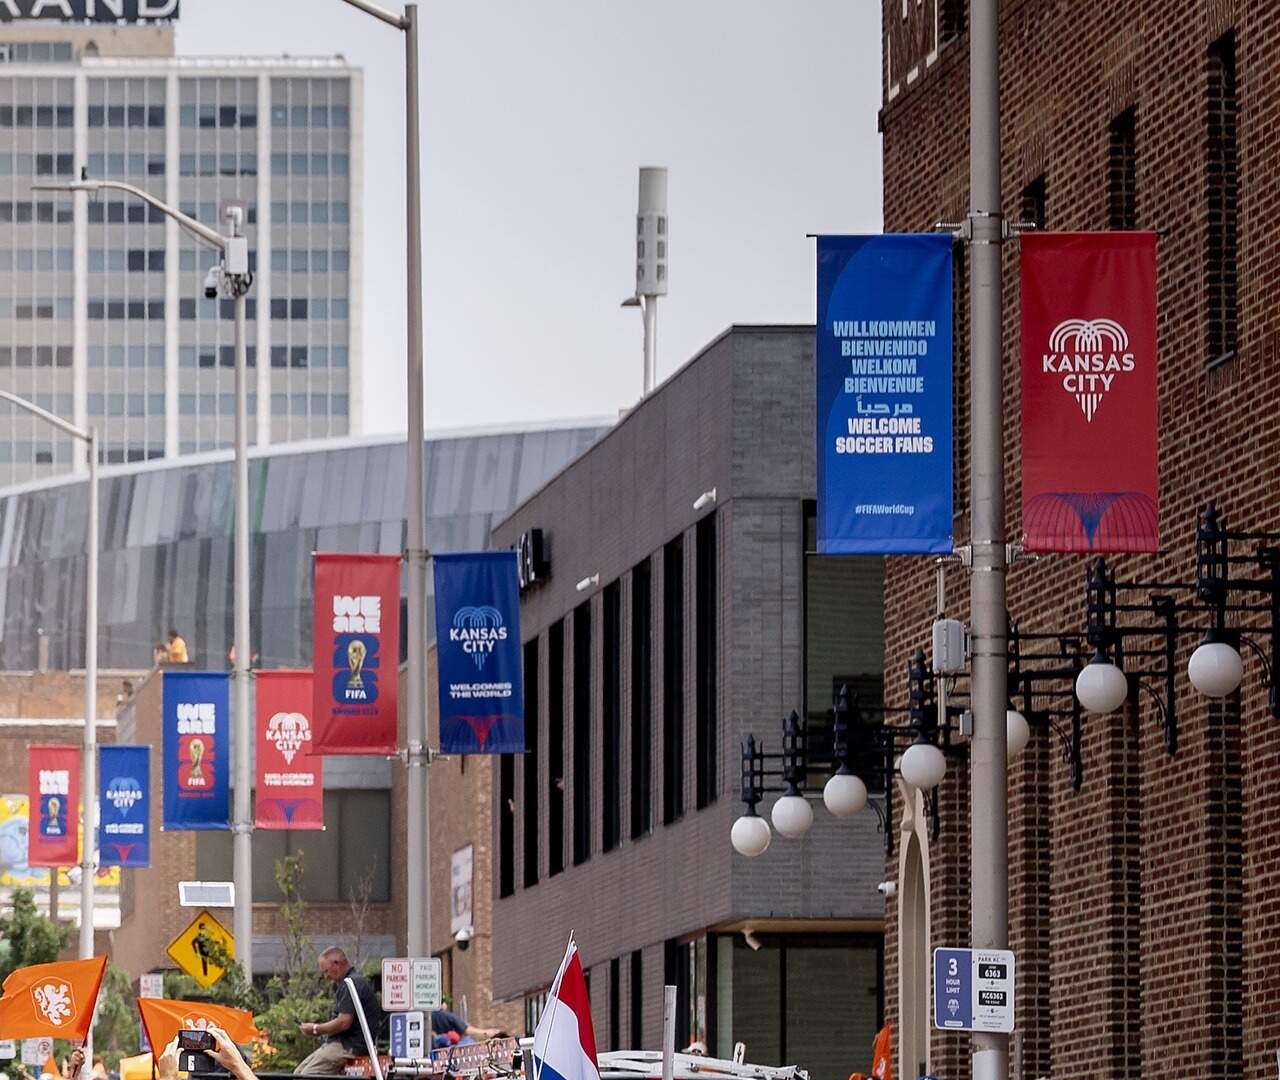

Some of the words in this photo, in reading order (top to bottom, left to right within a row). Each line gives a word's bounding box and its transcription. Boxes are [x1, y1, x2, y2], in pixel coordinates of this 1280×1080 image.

[833, 320, 936, 337] WILLKOMMEN
[841, 340, 928, 356] BIENVENIDO
[852, 359, 917, 374] WELKOM
[1042, 354, 1135, 373] KANSAS
[844, 377, 924, 393] BIENVENUE
[1063, 375, 1114, 392] CITY
[847, 418, 921, 434] WELCOME
[836, 437, 893, 453] SOCCER
[895, 436, 933, 453] FANS
[855, 504, 914, 515] #FIFAWorldCup
[450, 626, 507, 641] KANSAS
[463, 640, 494, 653] CITY
[450, 682, 512, 691] WELCOMES
[345, 689, 367, 699] FIFA
[450, 690, 472, 699] THE
[473, 690, 512, 698] WORLD
[265, 730, 312, 741] KANSAS
[275, 740, 302, 751] CITY
[391, 964, 403, 973] NO
[949, 958, 957, 976] 3
[984, 969, 1001, 978] 6363
[982, 992, 1003, 1000] KC6363
